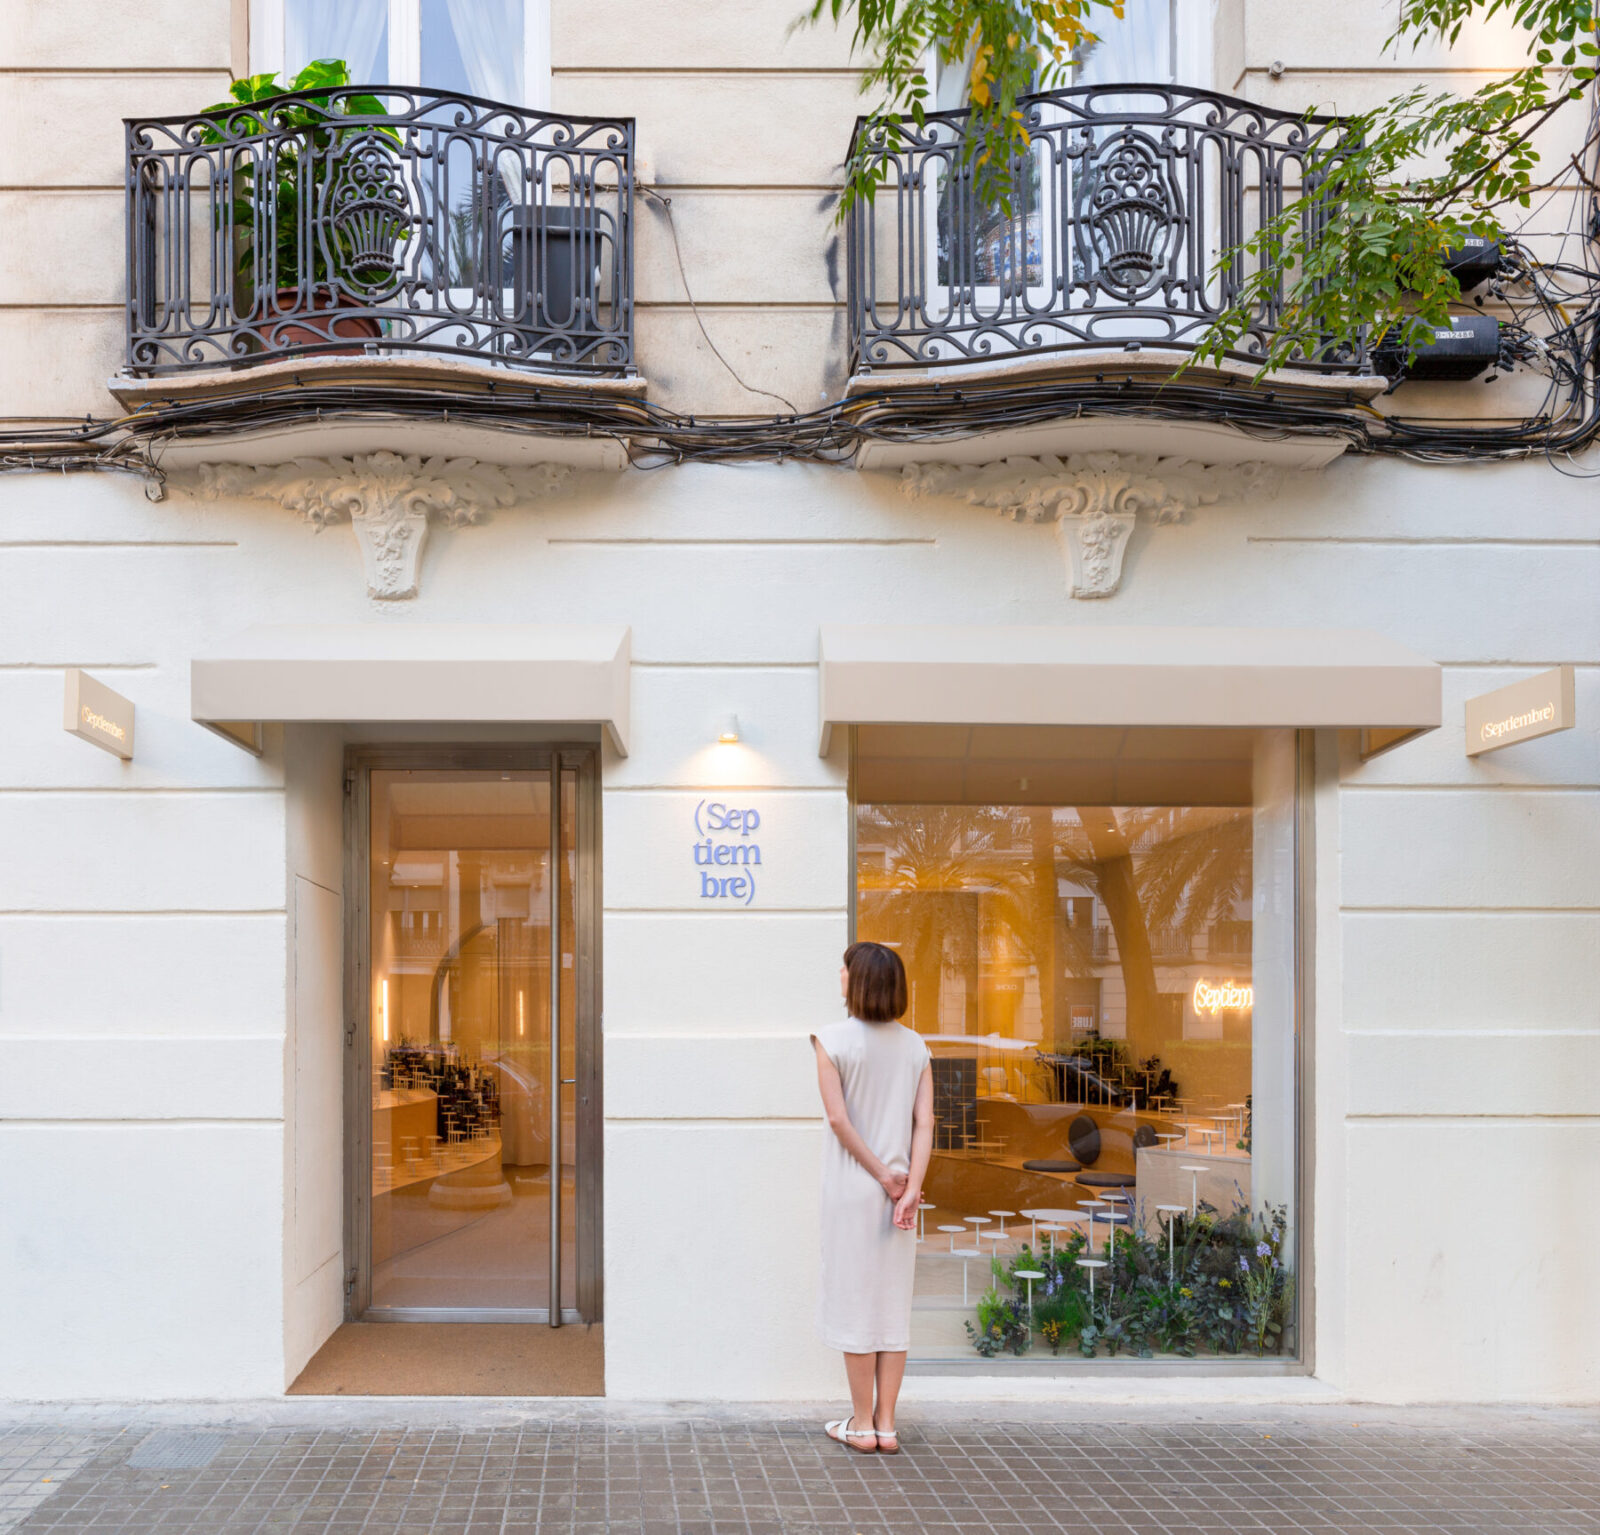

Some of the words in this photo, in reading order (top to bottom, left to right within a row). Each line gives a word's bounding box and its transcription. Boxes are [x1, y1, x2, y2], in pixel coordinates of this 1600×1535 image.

[1481, 701, 1555, 742] (Septiembre)
[695, 799, 761, 836] (Sep
[693, 838, 762, 866] tiem
[700, 867, 756, 906] bre)
